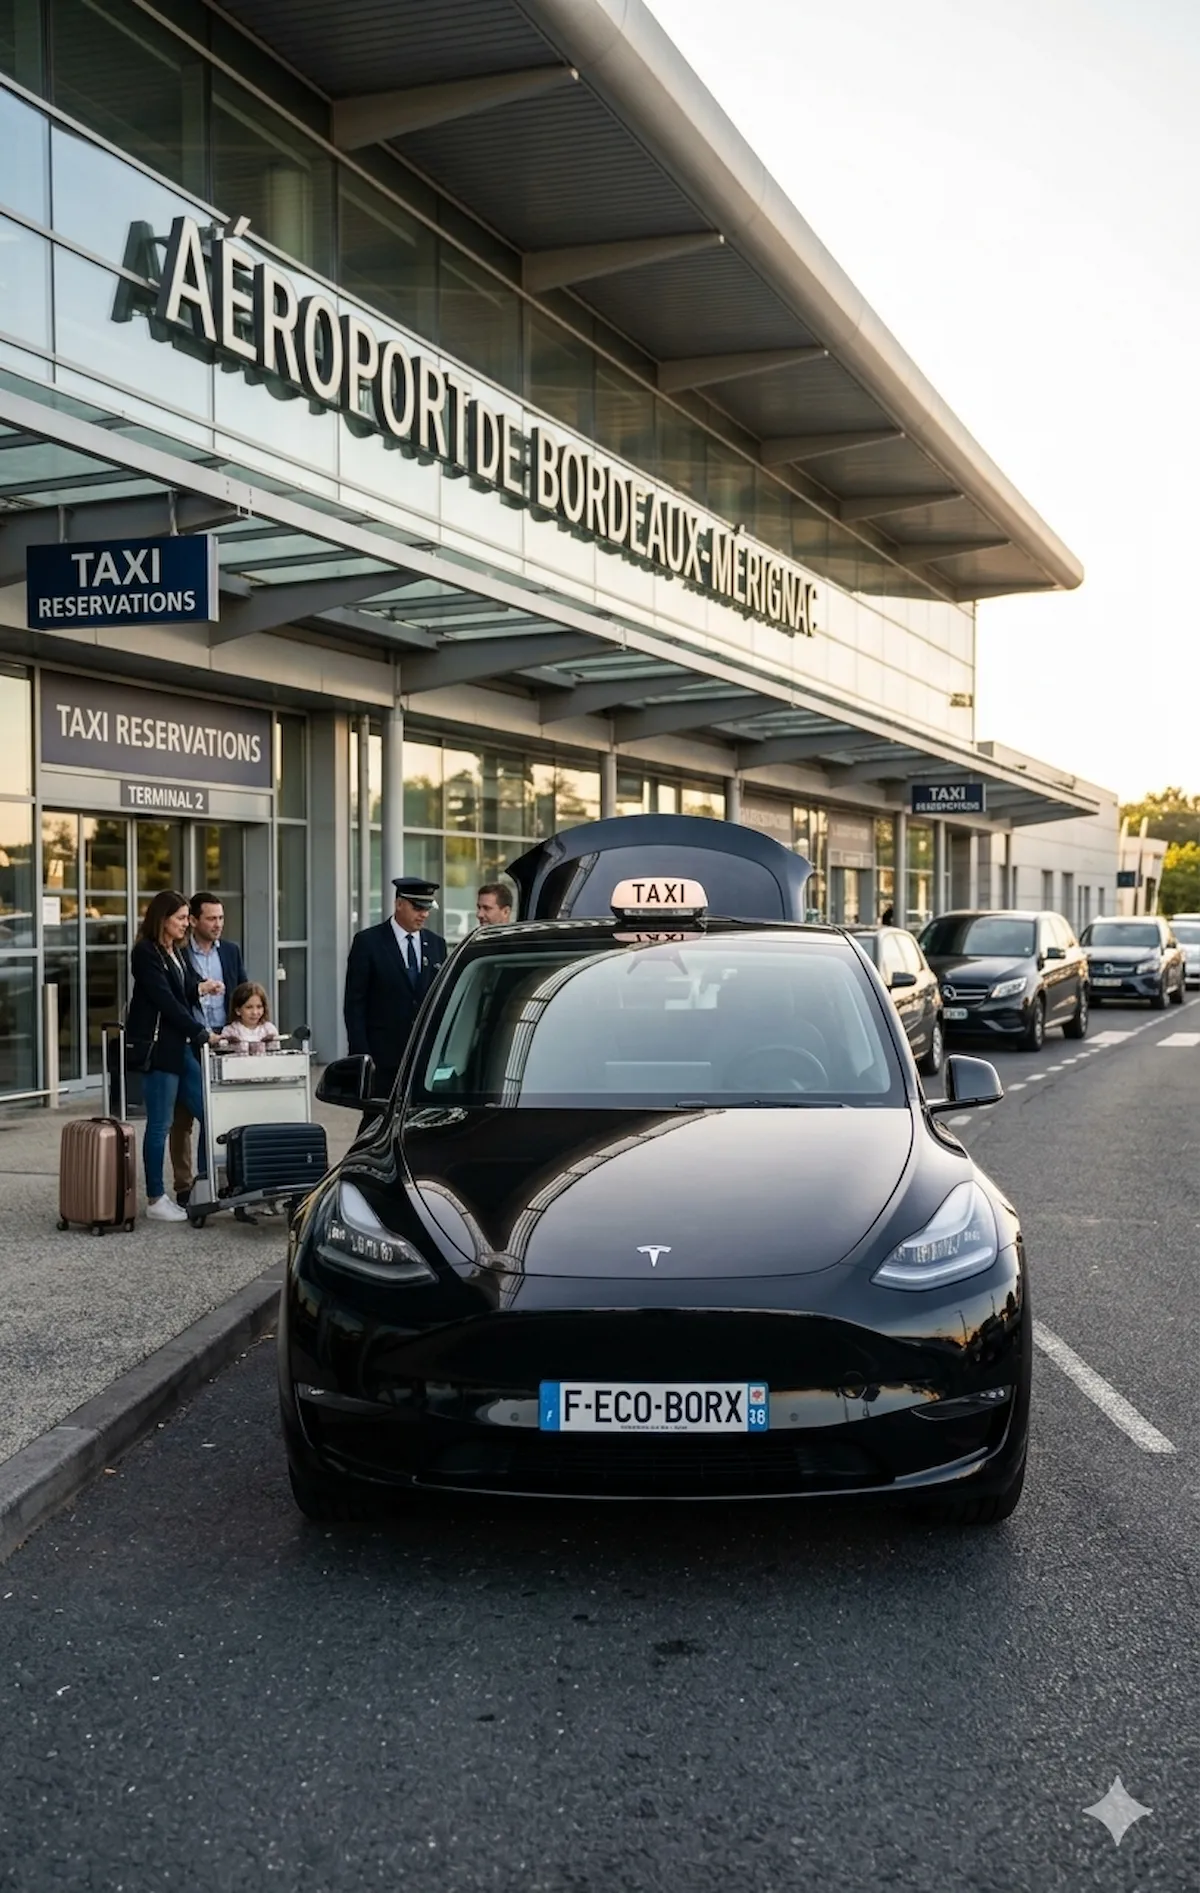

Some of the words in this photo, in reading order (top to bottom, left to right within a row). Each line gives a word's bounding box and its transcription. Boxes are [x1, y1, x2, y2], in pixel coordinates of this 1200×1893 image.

[158, 214, 472, 467] AÉROPORT
[470, 399, 526, 495] DE
[71, 548, 161, 588] TAXI
[38, 590, 196, 618] RESERVATIONS
[56, 704, 110, 742] TAXI
[115, 714, 262, 763] RESERVATIONS
[128, 785, 193, 809] TERMINAL
[194, 792, 205, 810] 2
[928, 786, 966, 801] TAXI
[632, 883, 685, 903] TAXI
[564, 1390, 742, 1423] F-ECO-BORX
